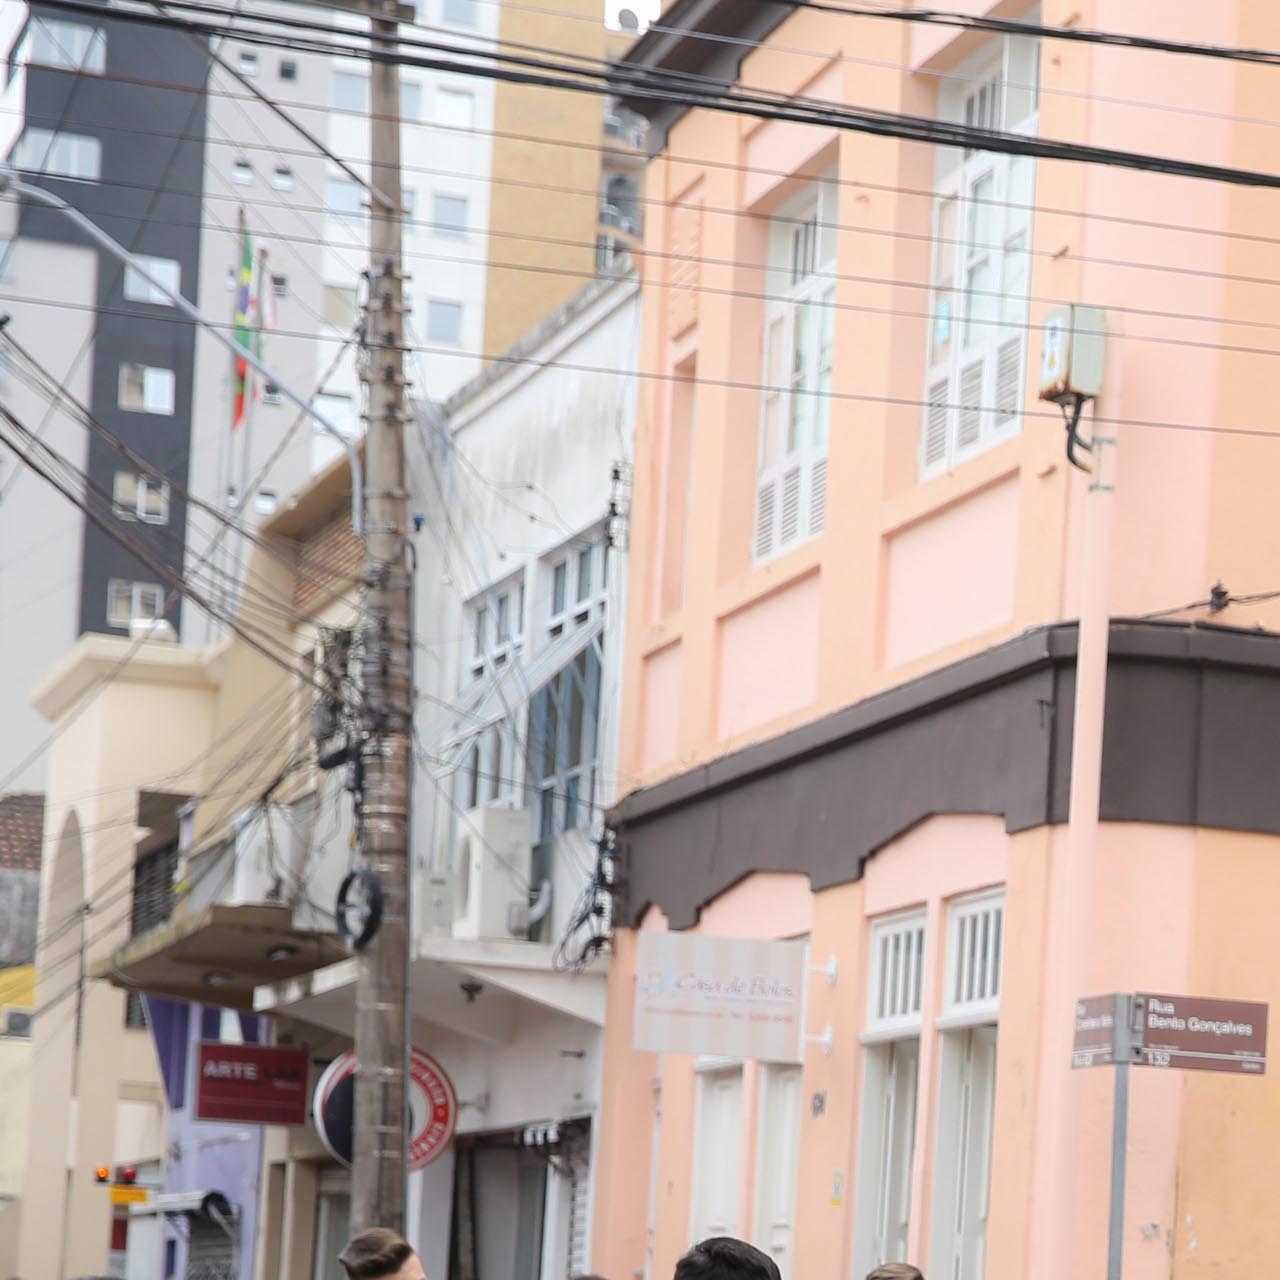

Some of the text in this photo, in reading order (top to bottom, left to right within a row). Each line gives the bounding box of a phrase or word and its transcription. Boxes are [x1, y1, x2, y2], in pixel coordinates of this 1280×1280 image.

[1148, 998, 1175, 1014] Rua
[1147, 1014, 1253, 1037] Bento Gonçalves
[204, 1060, 258, 1081] ARTE
